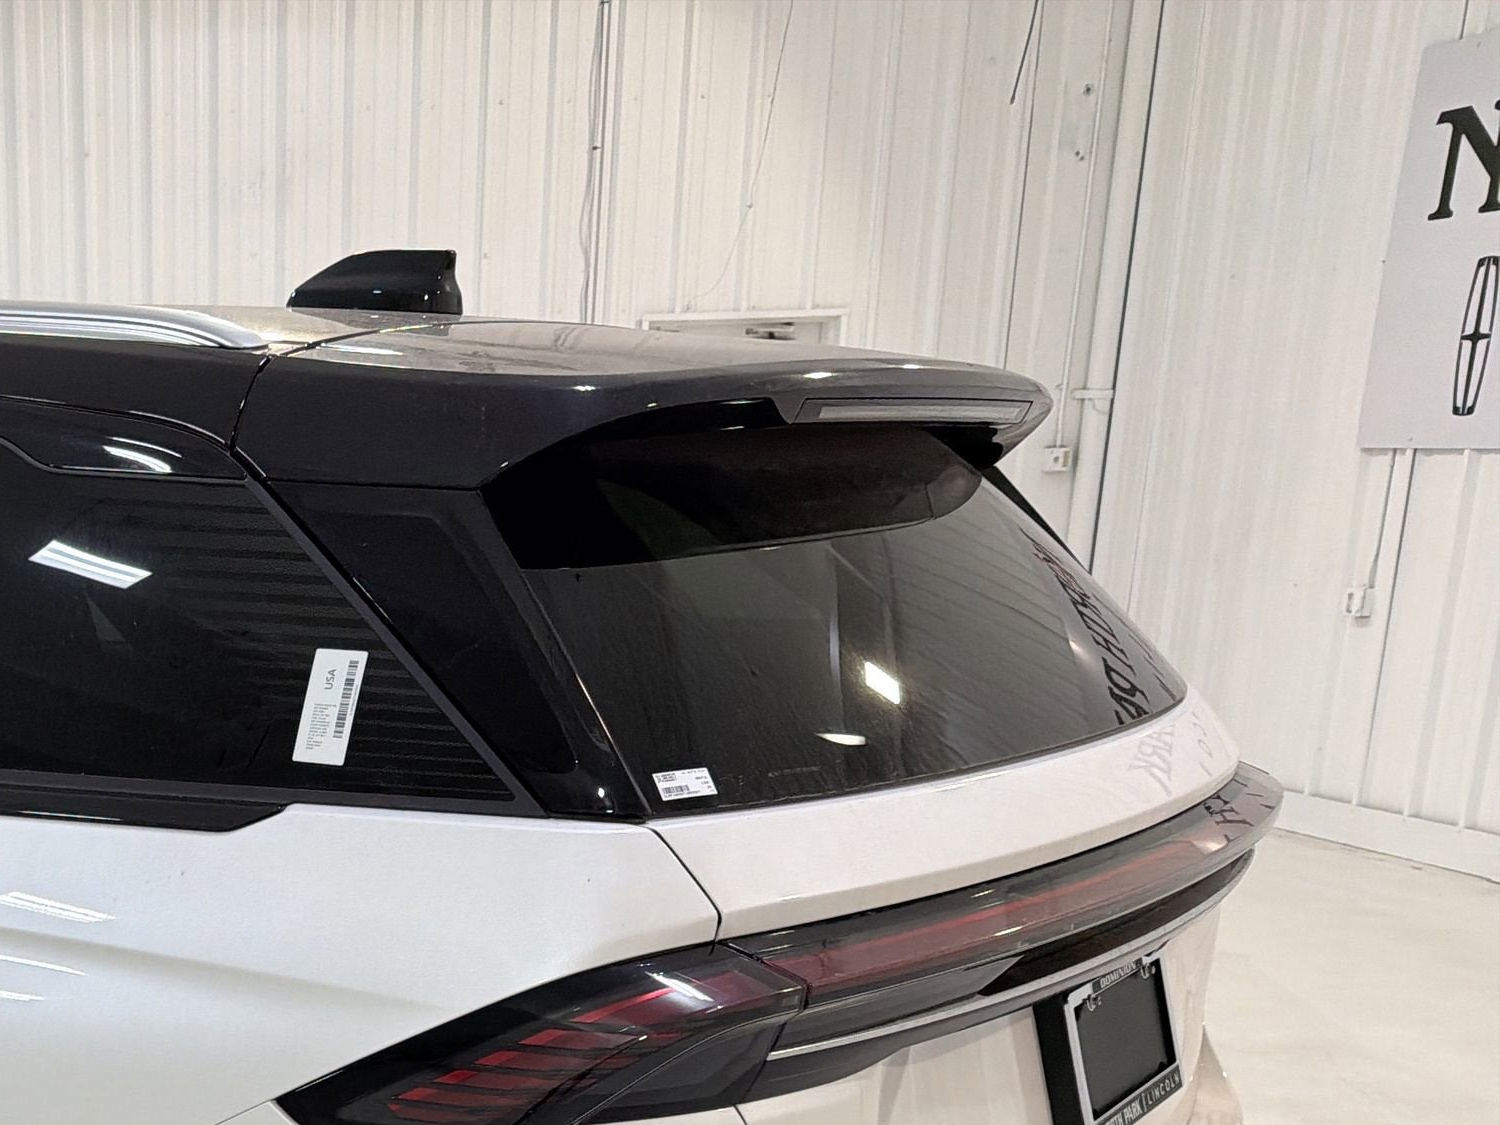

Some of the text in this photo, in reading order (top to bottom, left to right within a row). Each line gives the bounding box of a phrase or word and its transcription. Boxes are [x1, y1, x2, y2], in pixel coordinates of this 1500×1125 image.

[324, 669, 337, 690] USA
[1099, 961, 1139, 988] DOMINION
[1124, 1096, 1143, 1125] PARK
[1146, 1072, 1180, 1106] LINCOLN
